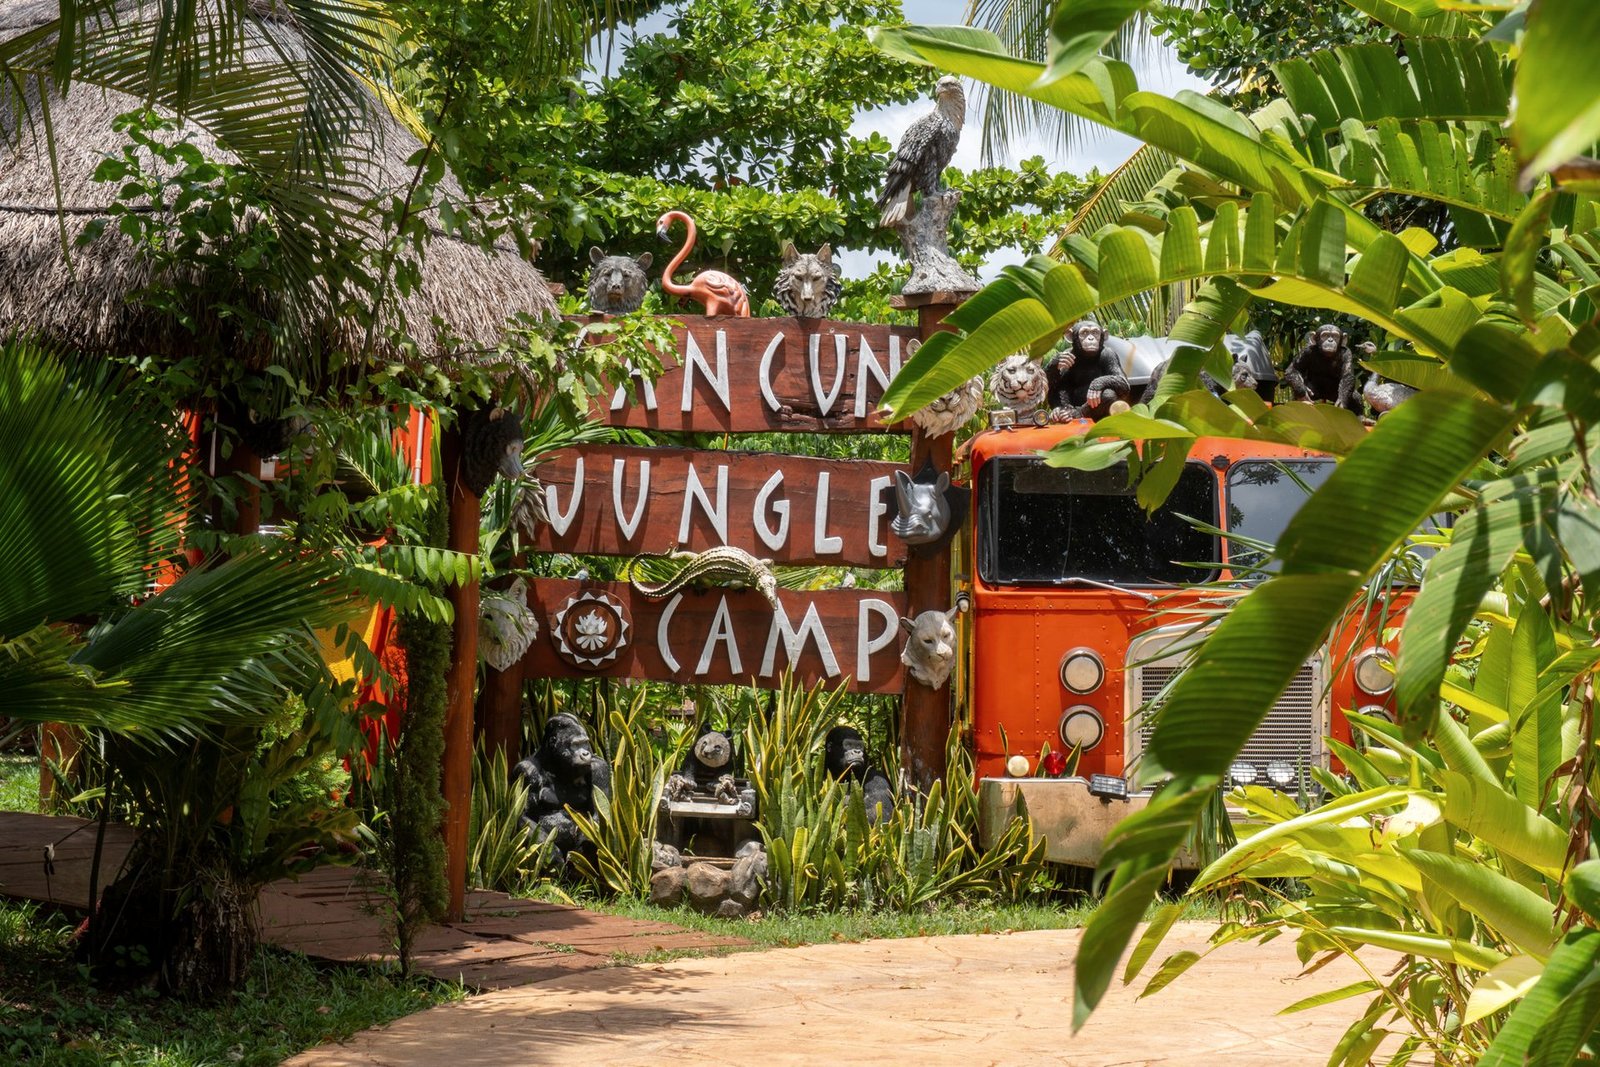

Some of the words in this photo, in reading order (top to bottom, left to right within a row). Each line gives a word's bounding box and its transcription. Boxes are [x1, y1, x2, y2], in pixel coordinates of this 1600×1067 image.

[575, 327, 901, 418] ANCUN
[546, 456, 890, 558] JUNGLE
[657, 592, 899, 682] CAMP
